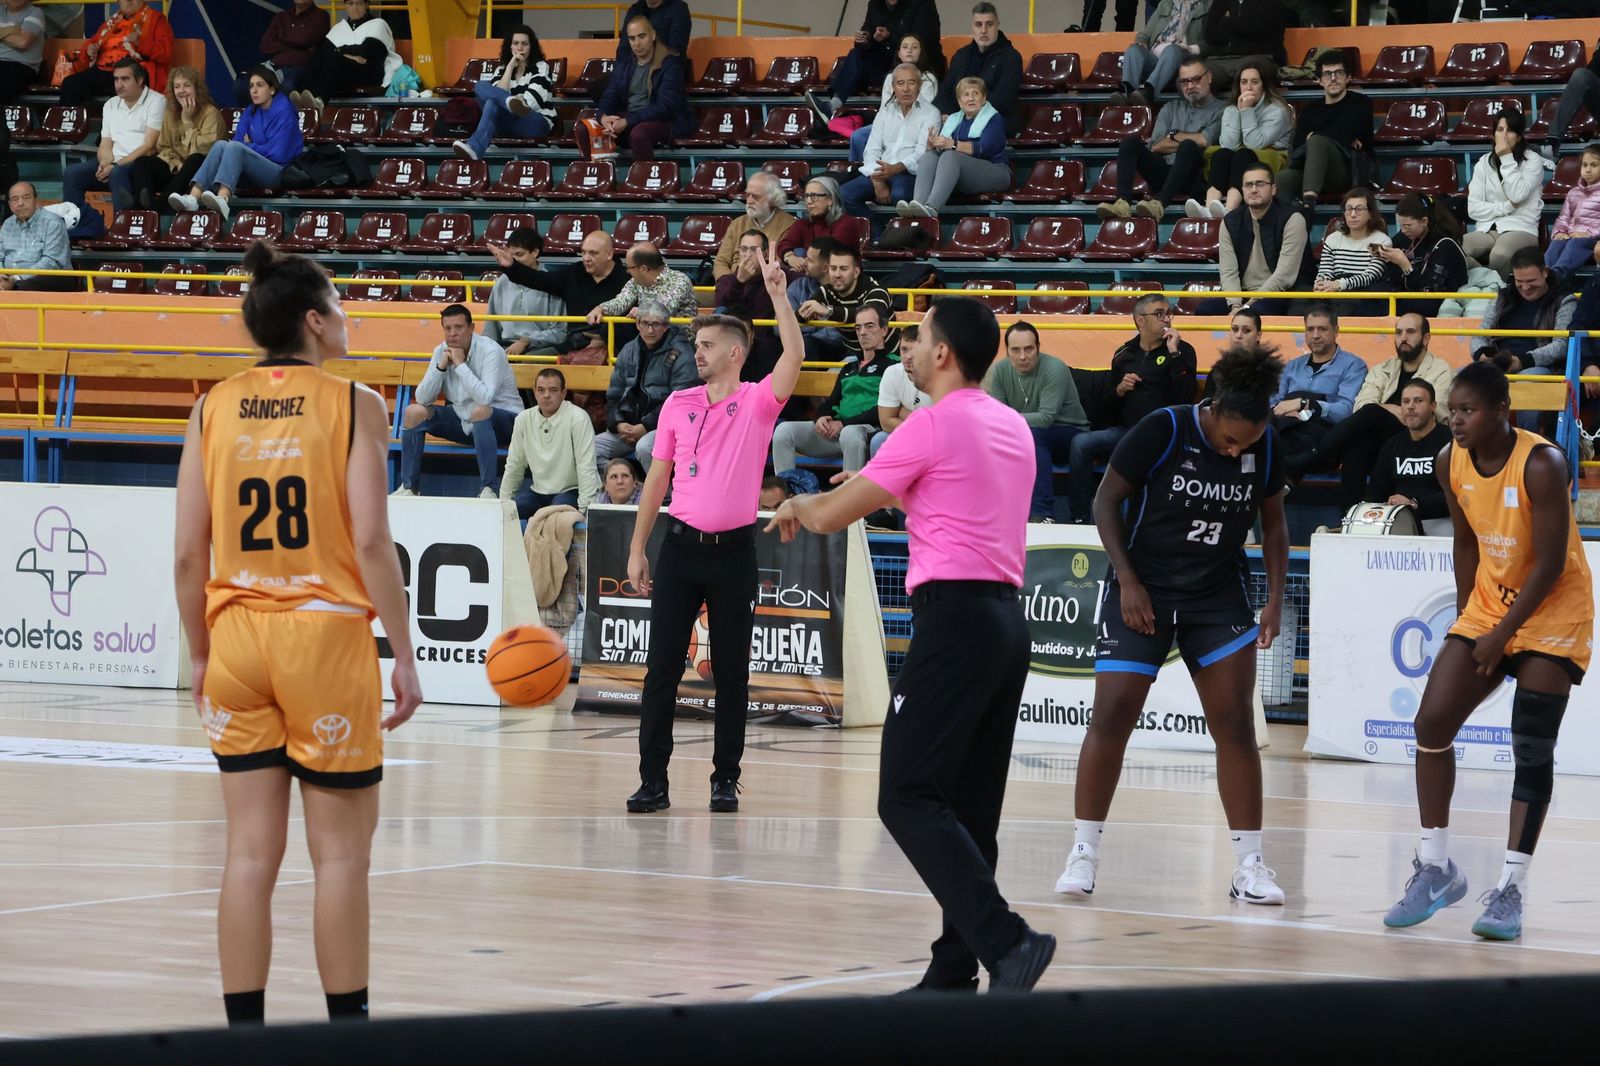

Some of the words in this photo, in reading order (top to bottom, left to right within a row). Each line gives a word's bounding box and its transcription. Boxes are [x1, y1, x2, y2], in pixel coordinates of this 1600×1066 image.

[1400, 49, 1416, 63] 11
[1469, 47, 1486, 62] 13
[1549, 45, 1565, 58] 15
[725, 62, 737, 72] 10
[790, 61, 800, 73] 8
[1050, 59, 1057, 72] 1
[5, 108, 20, 121] 28
[352, 112, 365, 121] 20
[788, 113, 797, 125] 6
[1122, 112, 1133, 125] 5
[397, 160, 412, 175] 16
[458, 164, 470, 174] 14
[521, 166, 534, 175] 12
[586, 166, 598, 176] 10
[650, 165, 660, 178] 8
[715, 166, 725, 178] 6
[782, 167, 789, 176] 4
[1054, 165, 1064, 178] 5
[131, 215, 144, 225] 22
[191, 214, 208, 227] 20
[254, 216, 266, 225] 18
[315, 214, 328, 227] 16
[379, 218, 391, 228] 14
[442, 219, 454, 228] 12
[507, 218, 520, 229] 10
[572, 219, 582, 232] 8
[638, 220, 647, 233] 6
[705, 222, 712, 232] 4
[980, 221, 990, 235] 5
[1051, 222, 1062, 236] 7
[1124, 221, 1135, 235] 9
[1195, 222, 1208, 234] 11
[239, 395, 305, 419] SÁNCHEZ
[1396, 456, 1434, 475] VANS
[1172, 474, 1252, 501] DOMUSA
[238, 475, 309, 552] 28
[1186, 519, 1224, 545] 23
[1367, 547, 1426, 572] LAVANDERÍA
[1429, 551, 1436, 571] Y
[0, 618, 83, 651] oletas
[93, 622, 157, 654] salud
[750, 623, 824, 665] SUEÑA
[1031, 641, 1074, 656] butidos
[1075, 646, 1085, 659] y
[416, 646, 487, 664] CRUCES
[599, 648, 625, 662] SIN
[749, 660, 769, 672] SIN
[597, 690, 640, 700] TENEMOS
[1367, 722, 1415, 738] Especialista
